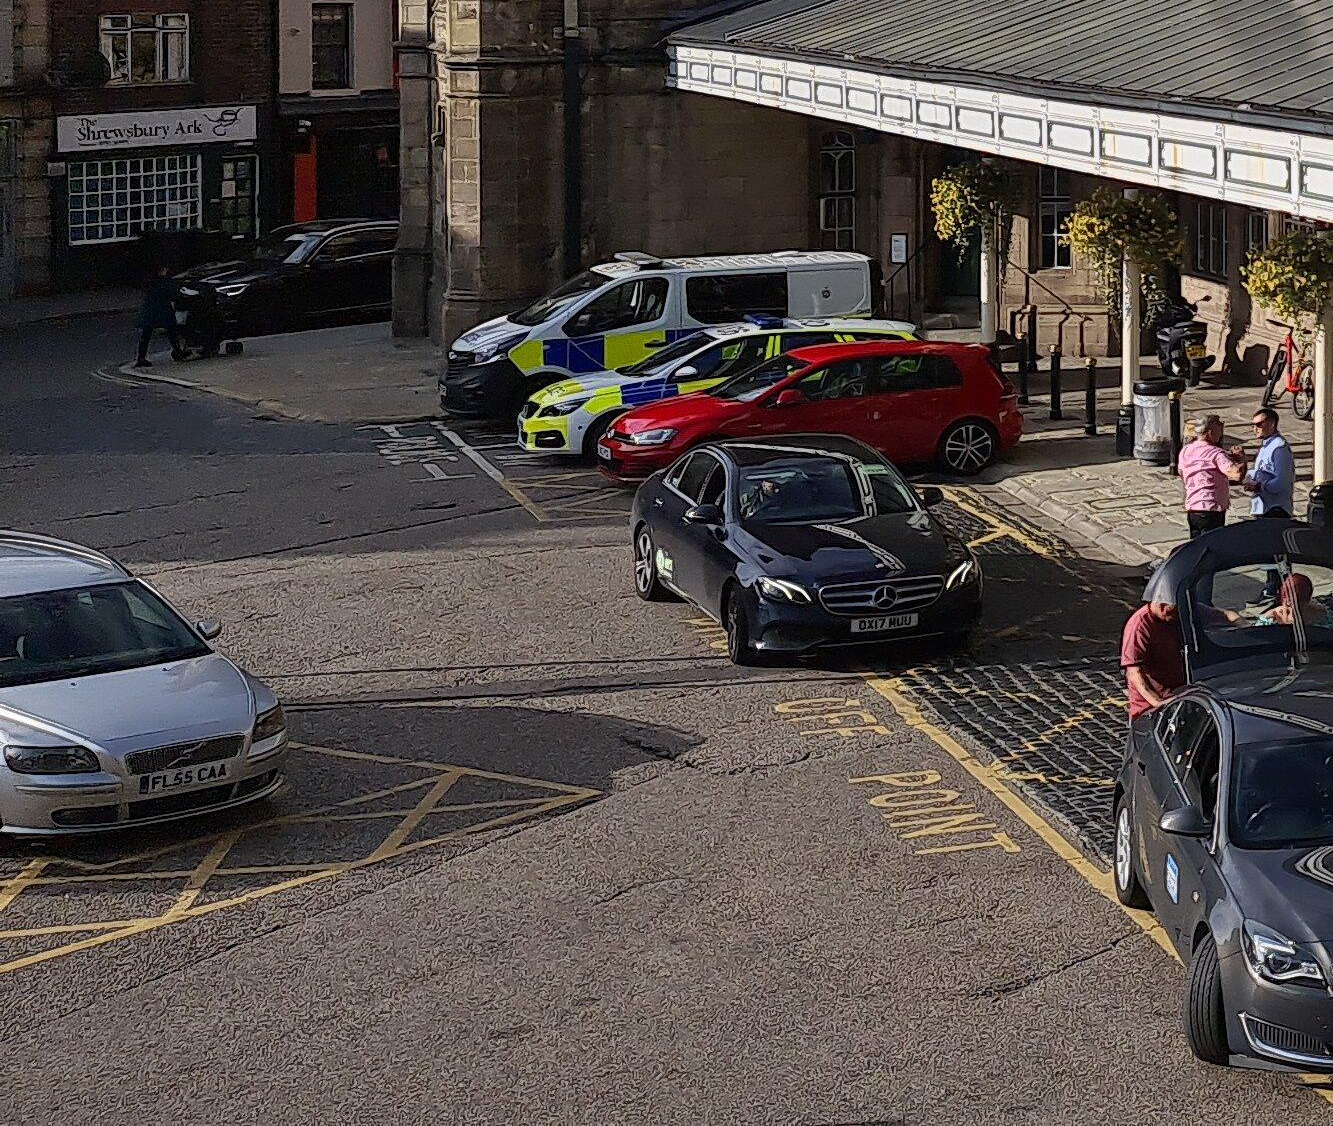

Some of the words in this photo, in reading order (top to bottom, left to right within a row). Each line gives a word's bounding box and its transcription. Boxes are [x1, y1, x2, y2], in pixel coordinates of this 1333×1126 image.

[77, 123, 170, 142] Shrewsbury
[174, 119, 203, 135] Ark
[774, 697, 892, 737] OFF
[197, 763, 227, 782] CAA
[848, 769, 1023, 856] POINT
